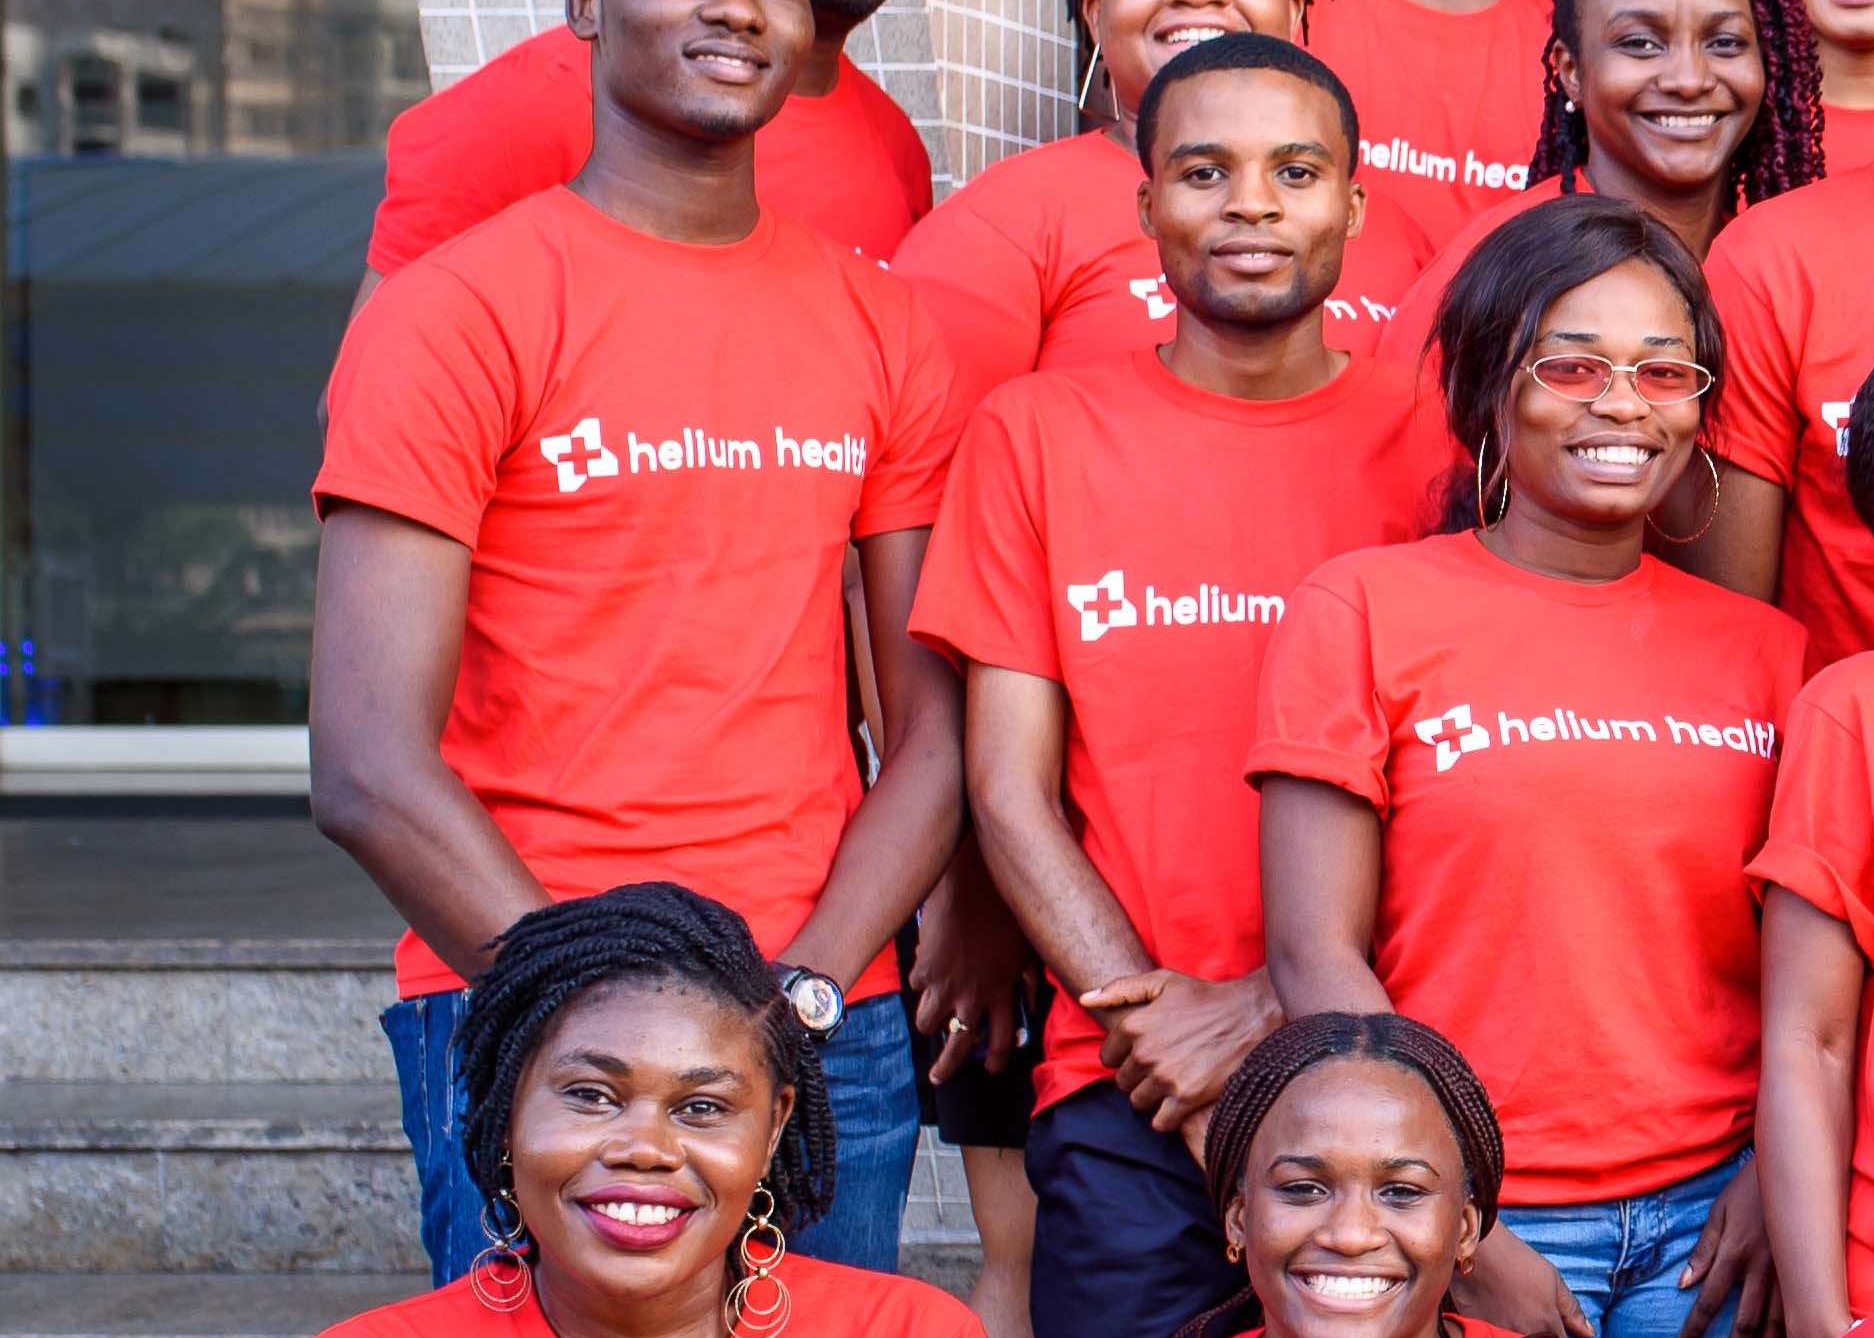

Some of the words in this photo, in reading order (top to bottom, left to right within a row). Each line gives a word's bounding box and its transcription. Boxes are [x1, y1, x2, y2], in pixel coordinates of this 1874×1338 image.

[1464, 150, 1530, 191] hea
[626, 426, 763, 475] helium
[1144, 583, 1286, 627] helium
[1497, 707, 1658, 747] helium
